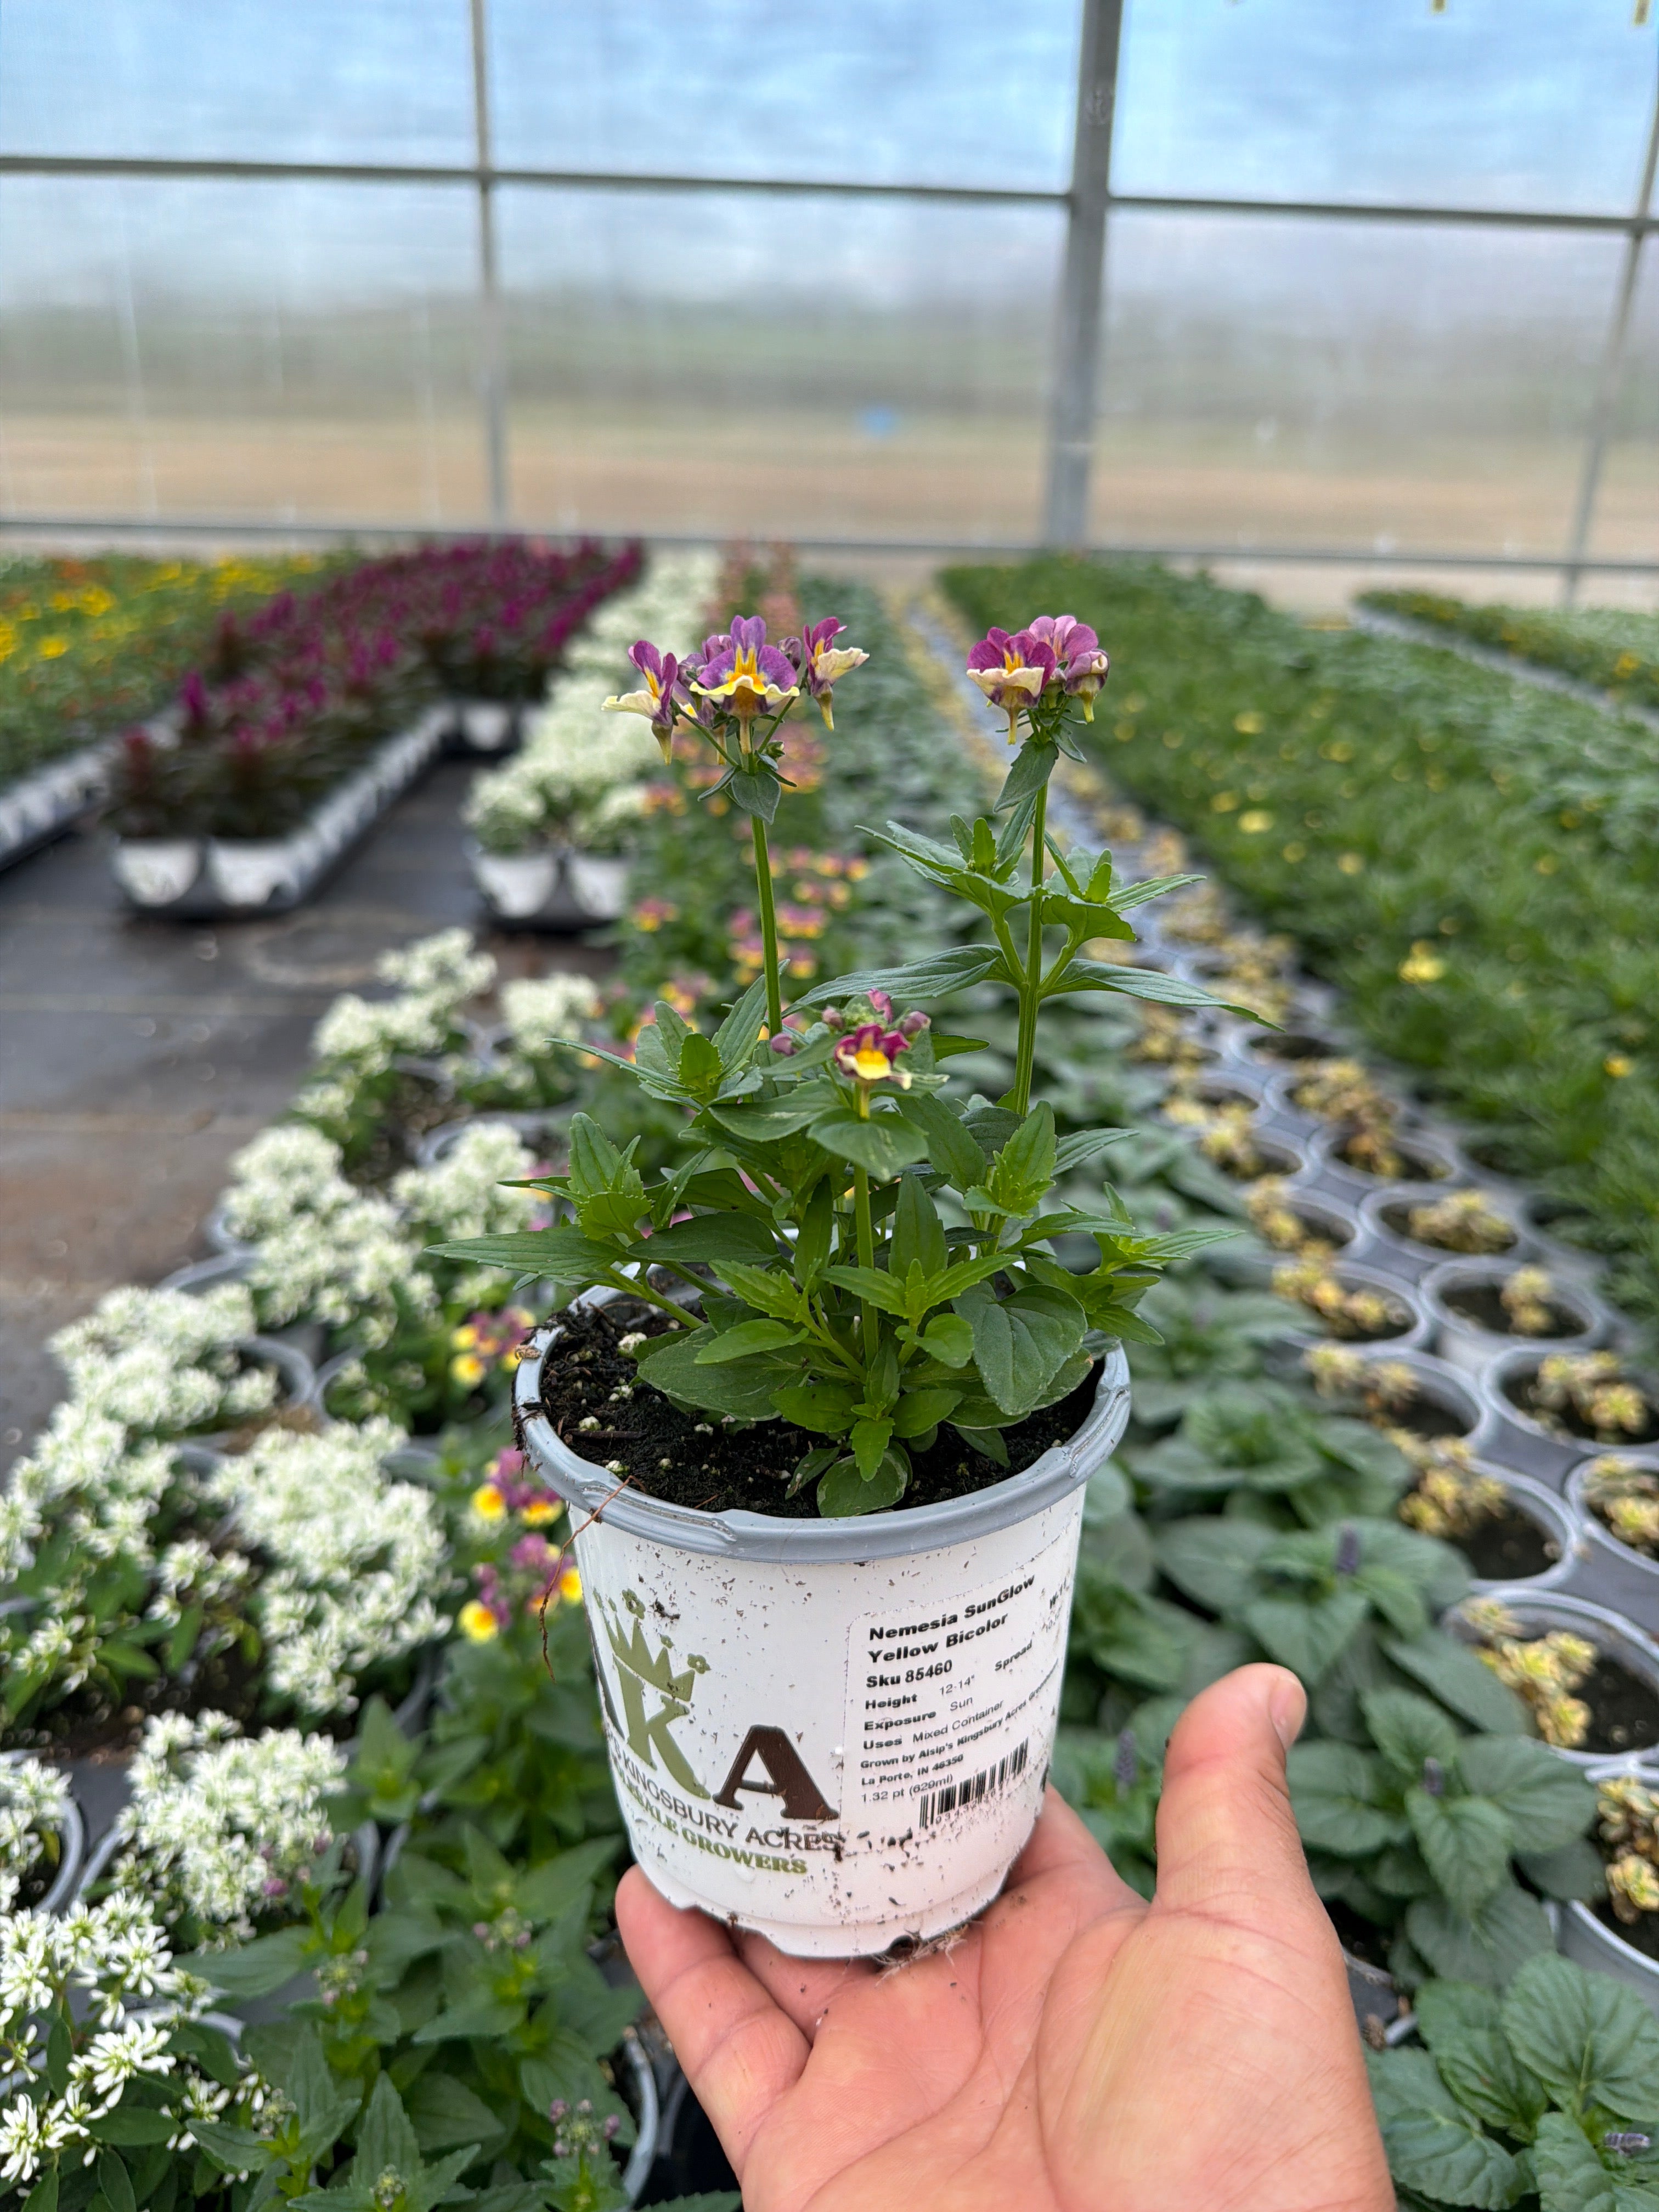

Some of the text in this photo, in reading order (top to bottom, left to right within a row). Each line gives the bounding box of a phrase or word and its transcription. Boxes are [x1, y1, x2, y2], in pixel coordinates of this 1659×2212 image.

[870, 1575, 1035, 1640] Nemesia SunGlow
[868, 1613, 1009, 1663] Yellow Bicolor
[865, 1693, 918, 1709] Height
[995, 1639, 1032, 1671] Spread
[866, 1660, 952, 1688] Sku 85460
[860, 1699, 1026, 1768] Grown by Alsip's Kingsbury Acres
[864, 1697, 973, 1731] Exposure Sun
[864, 1700, 1004, 1750] Uses Mixed Container
[861, 1778, 875, 1786] La
[917, 1766, 929, 1775] IN
[932, 1753, 963, 1771] 46350
[861, 1773, 953, 1802] 1.32 pt (629ml)
[623, 1750, 842, 1851] KINGSBURY ACRES
[682, 1827, 807, 1874] GROWERS
